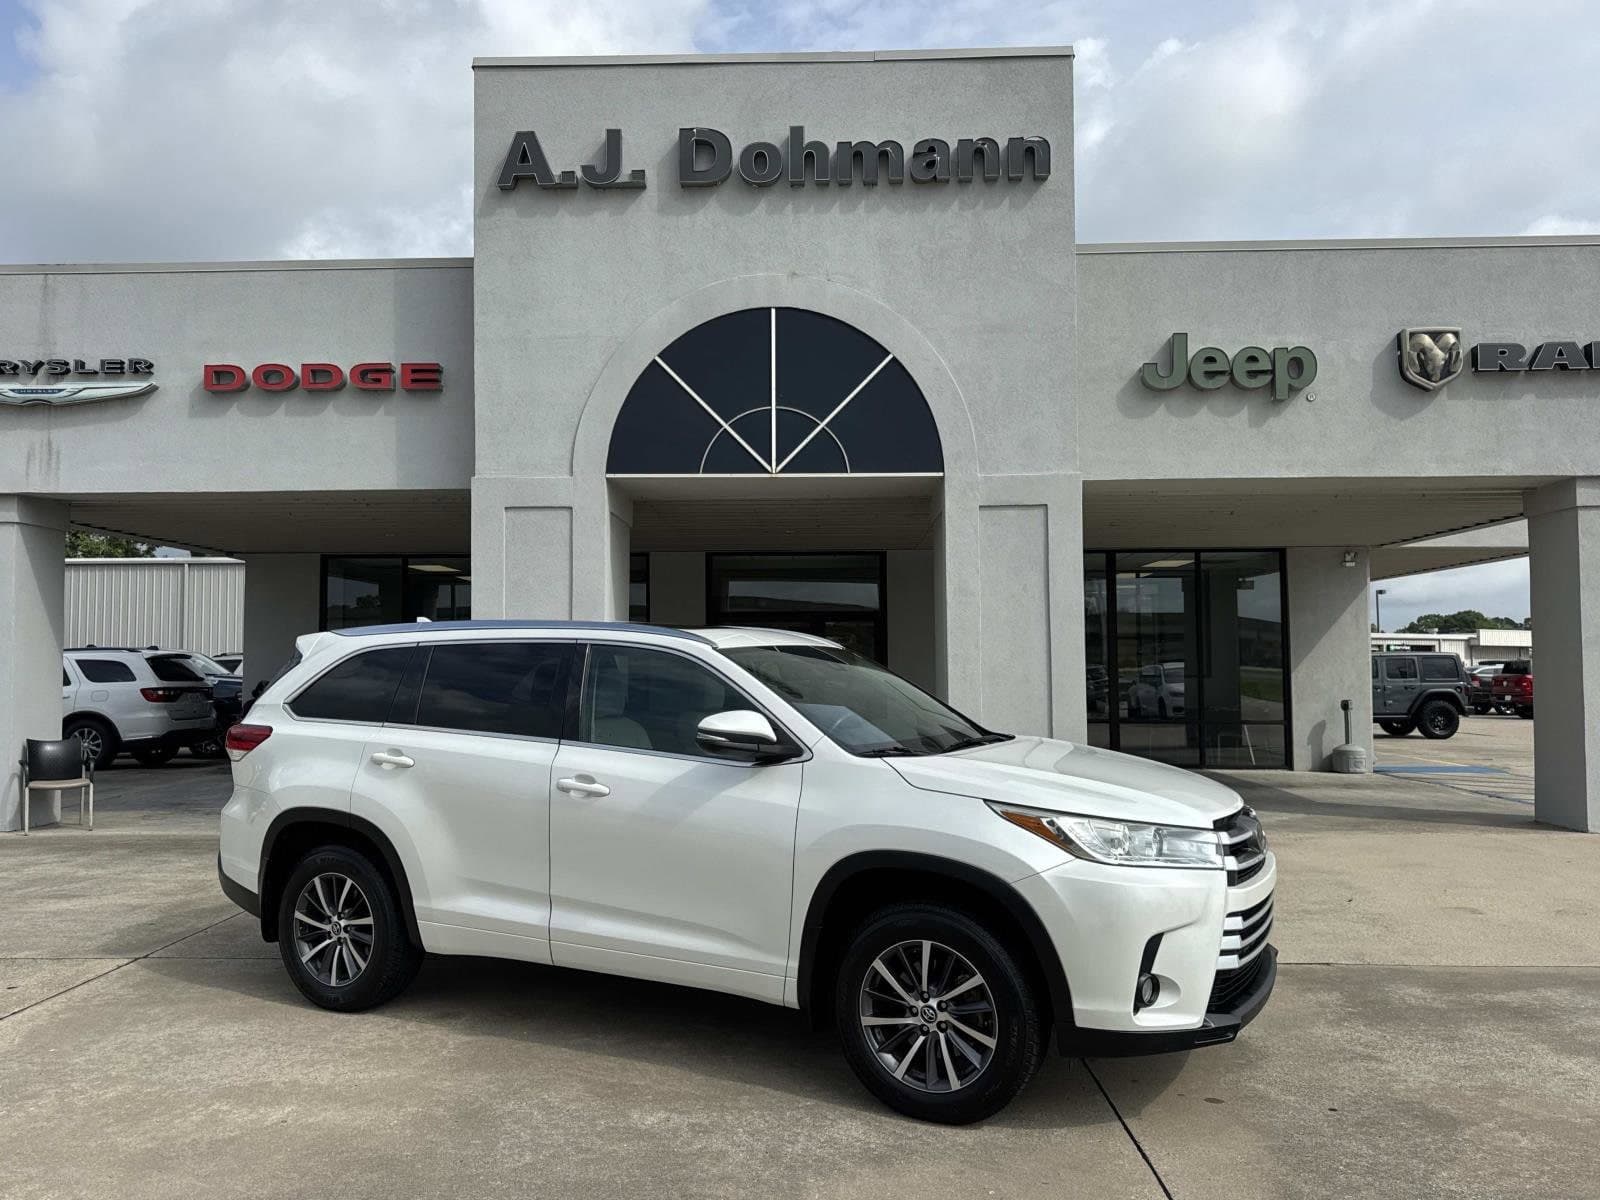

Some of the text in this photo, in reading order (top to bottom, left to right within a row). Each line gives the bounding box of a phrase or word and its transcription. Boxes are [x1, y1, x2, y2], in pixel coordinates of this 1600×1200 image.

[497, 125, 1051, 190] A.J. Dohmann
[204, 363, 443, 392] DODGE
[1142, 332, 1318, 401] Jeep
[1472, 340, 1600, 371] RA
